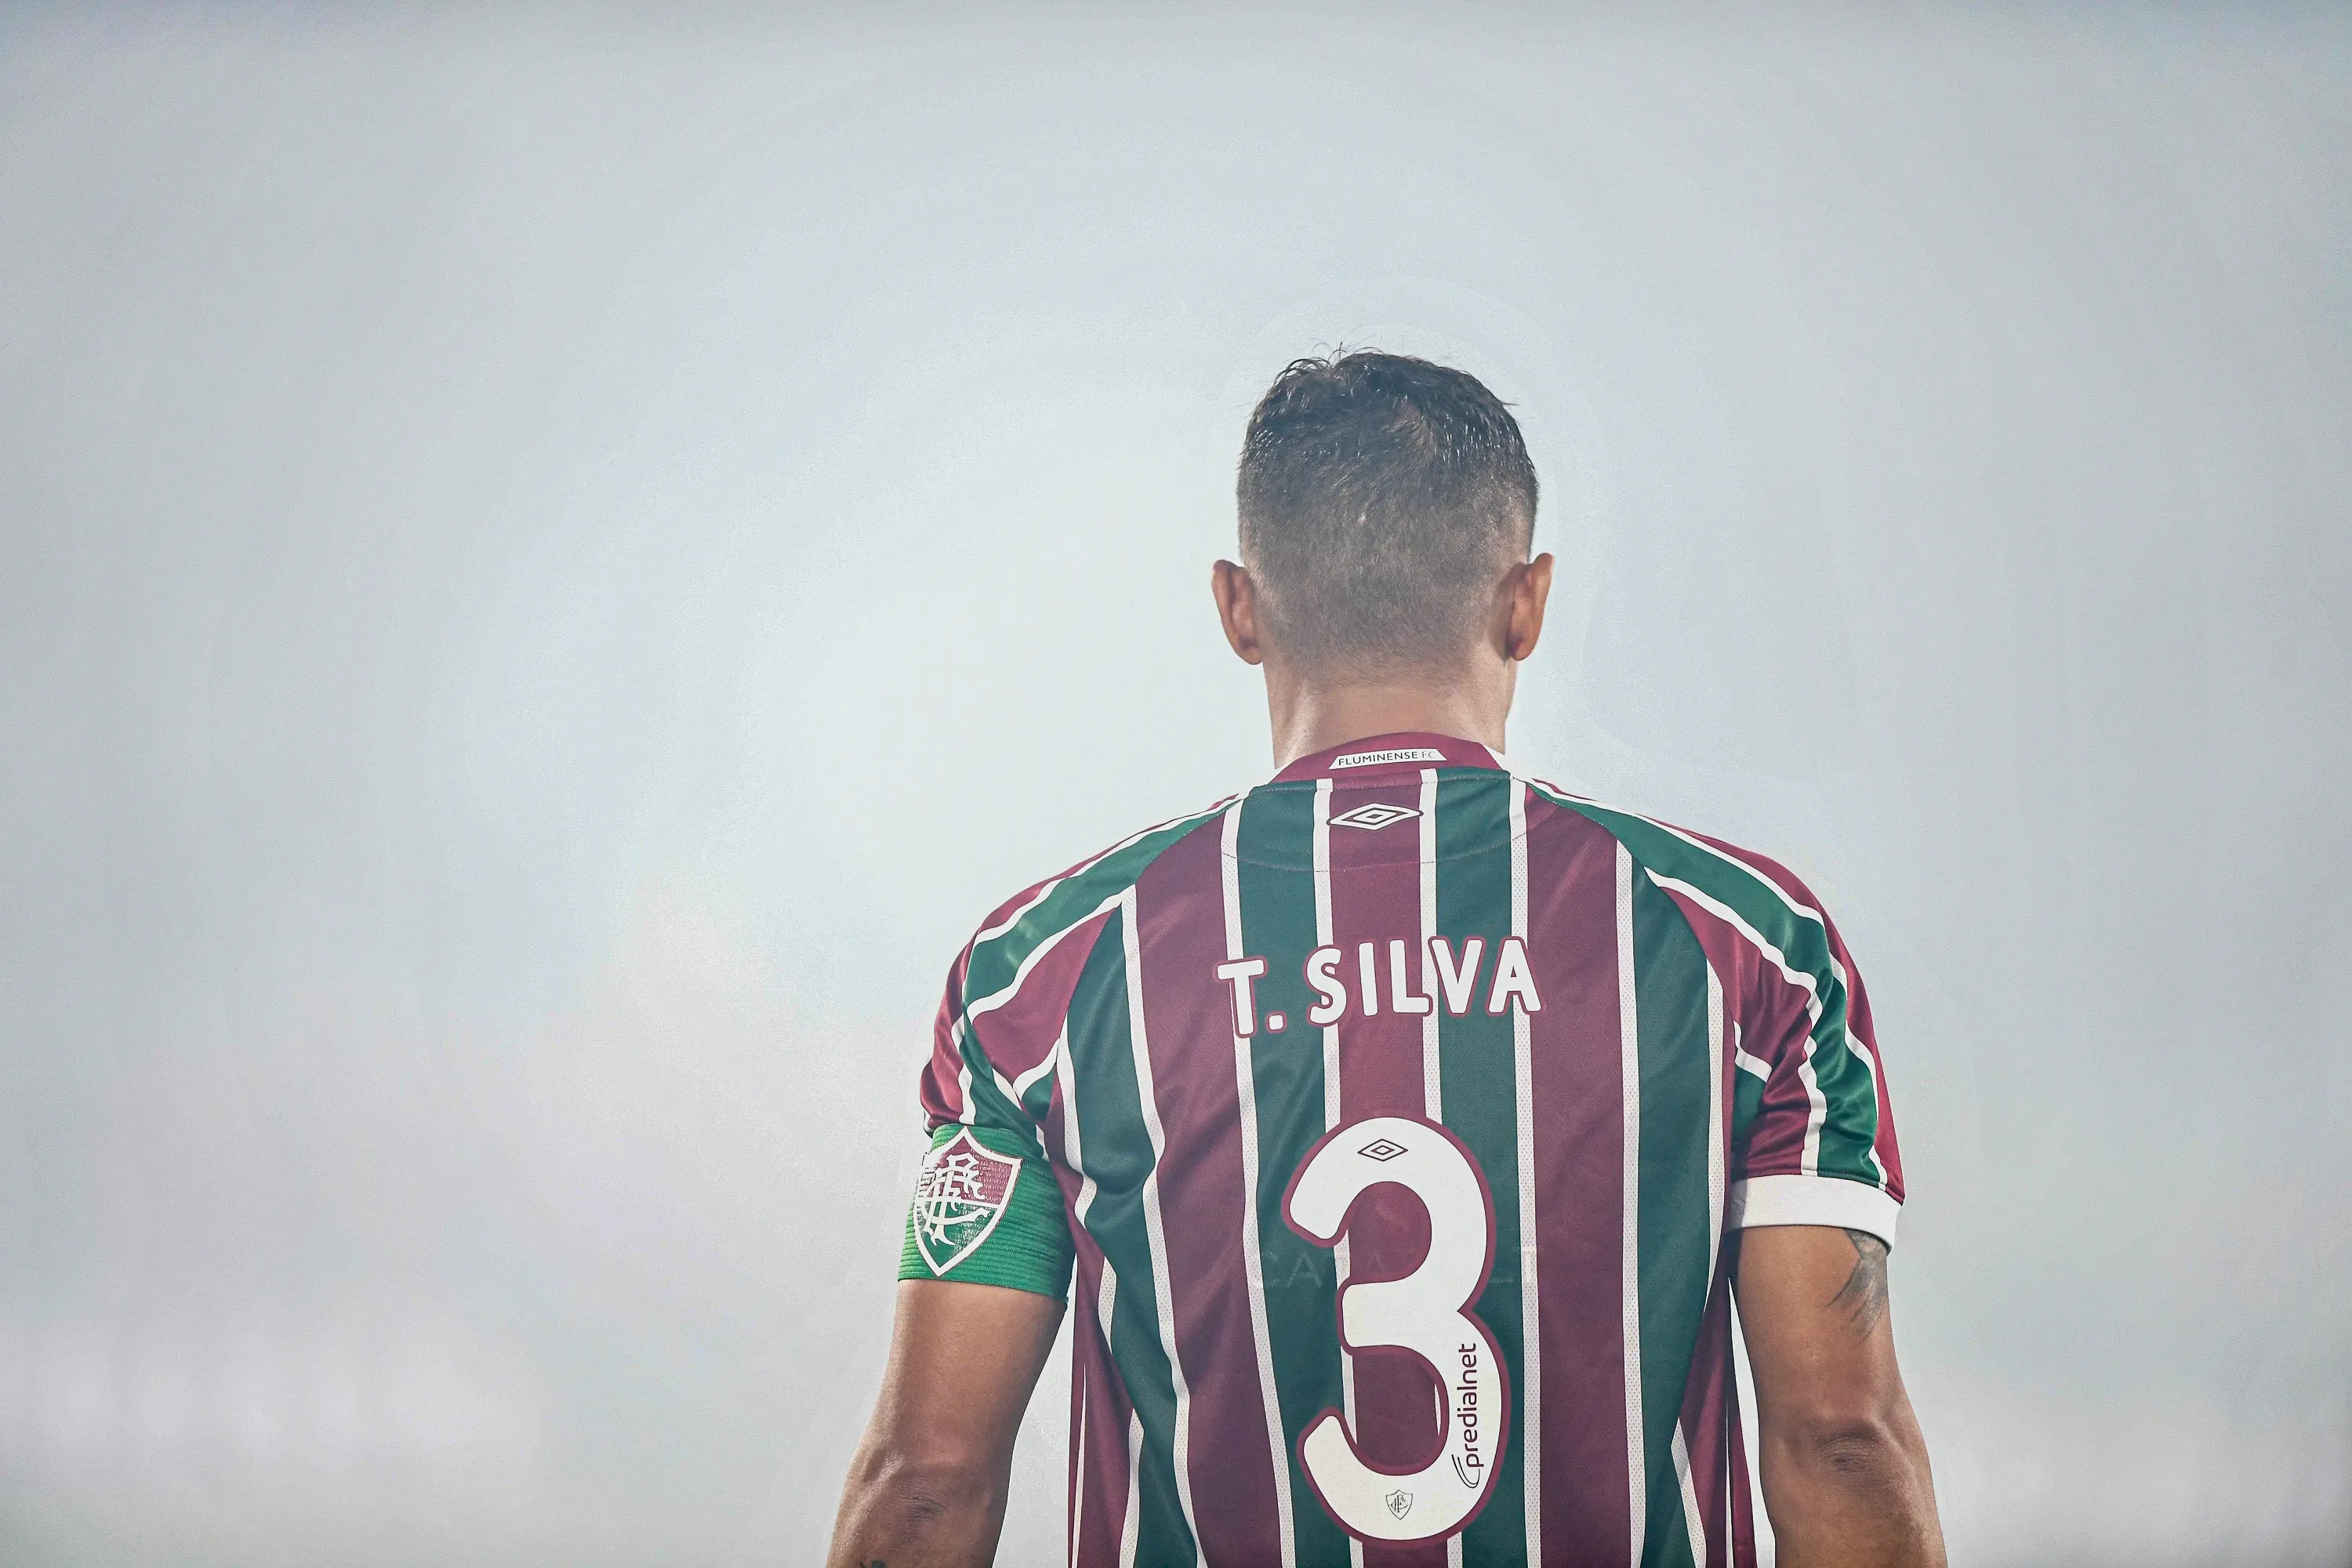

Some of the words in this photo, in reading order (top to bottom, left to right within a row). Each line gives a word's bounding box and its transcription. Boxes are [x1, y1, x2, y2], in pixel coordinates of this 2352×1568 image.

[1338, 751, 1417, 766] FLUMINENSE
[1421, 750, 1436, 759] FC
[1216, 958, 1285, 1036] T.
[1305, 937, 1543, 1026] SILVA
[1286, 1115, 1506, 1543] 3
[1457, 1342, 1484, 1468] predialnet
